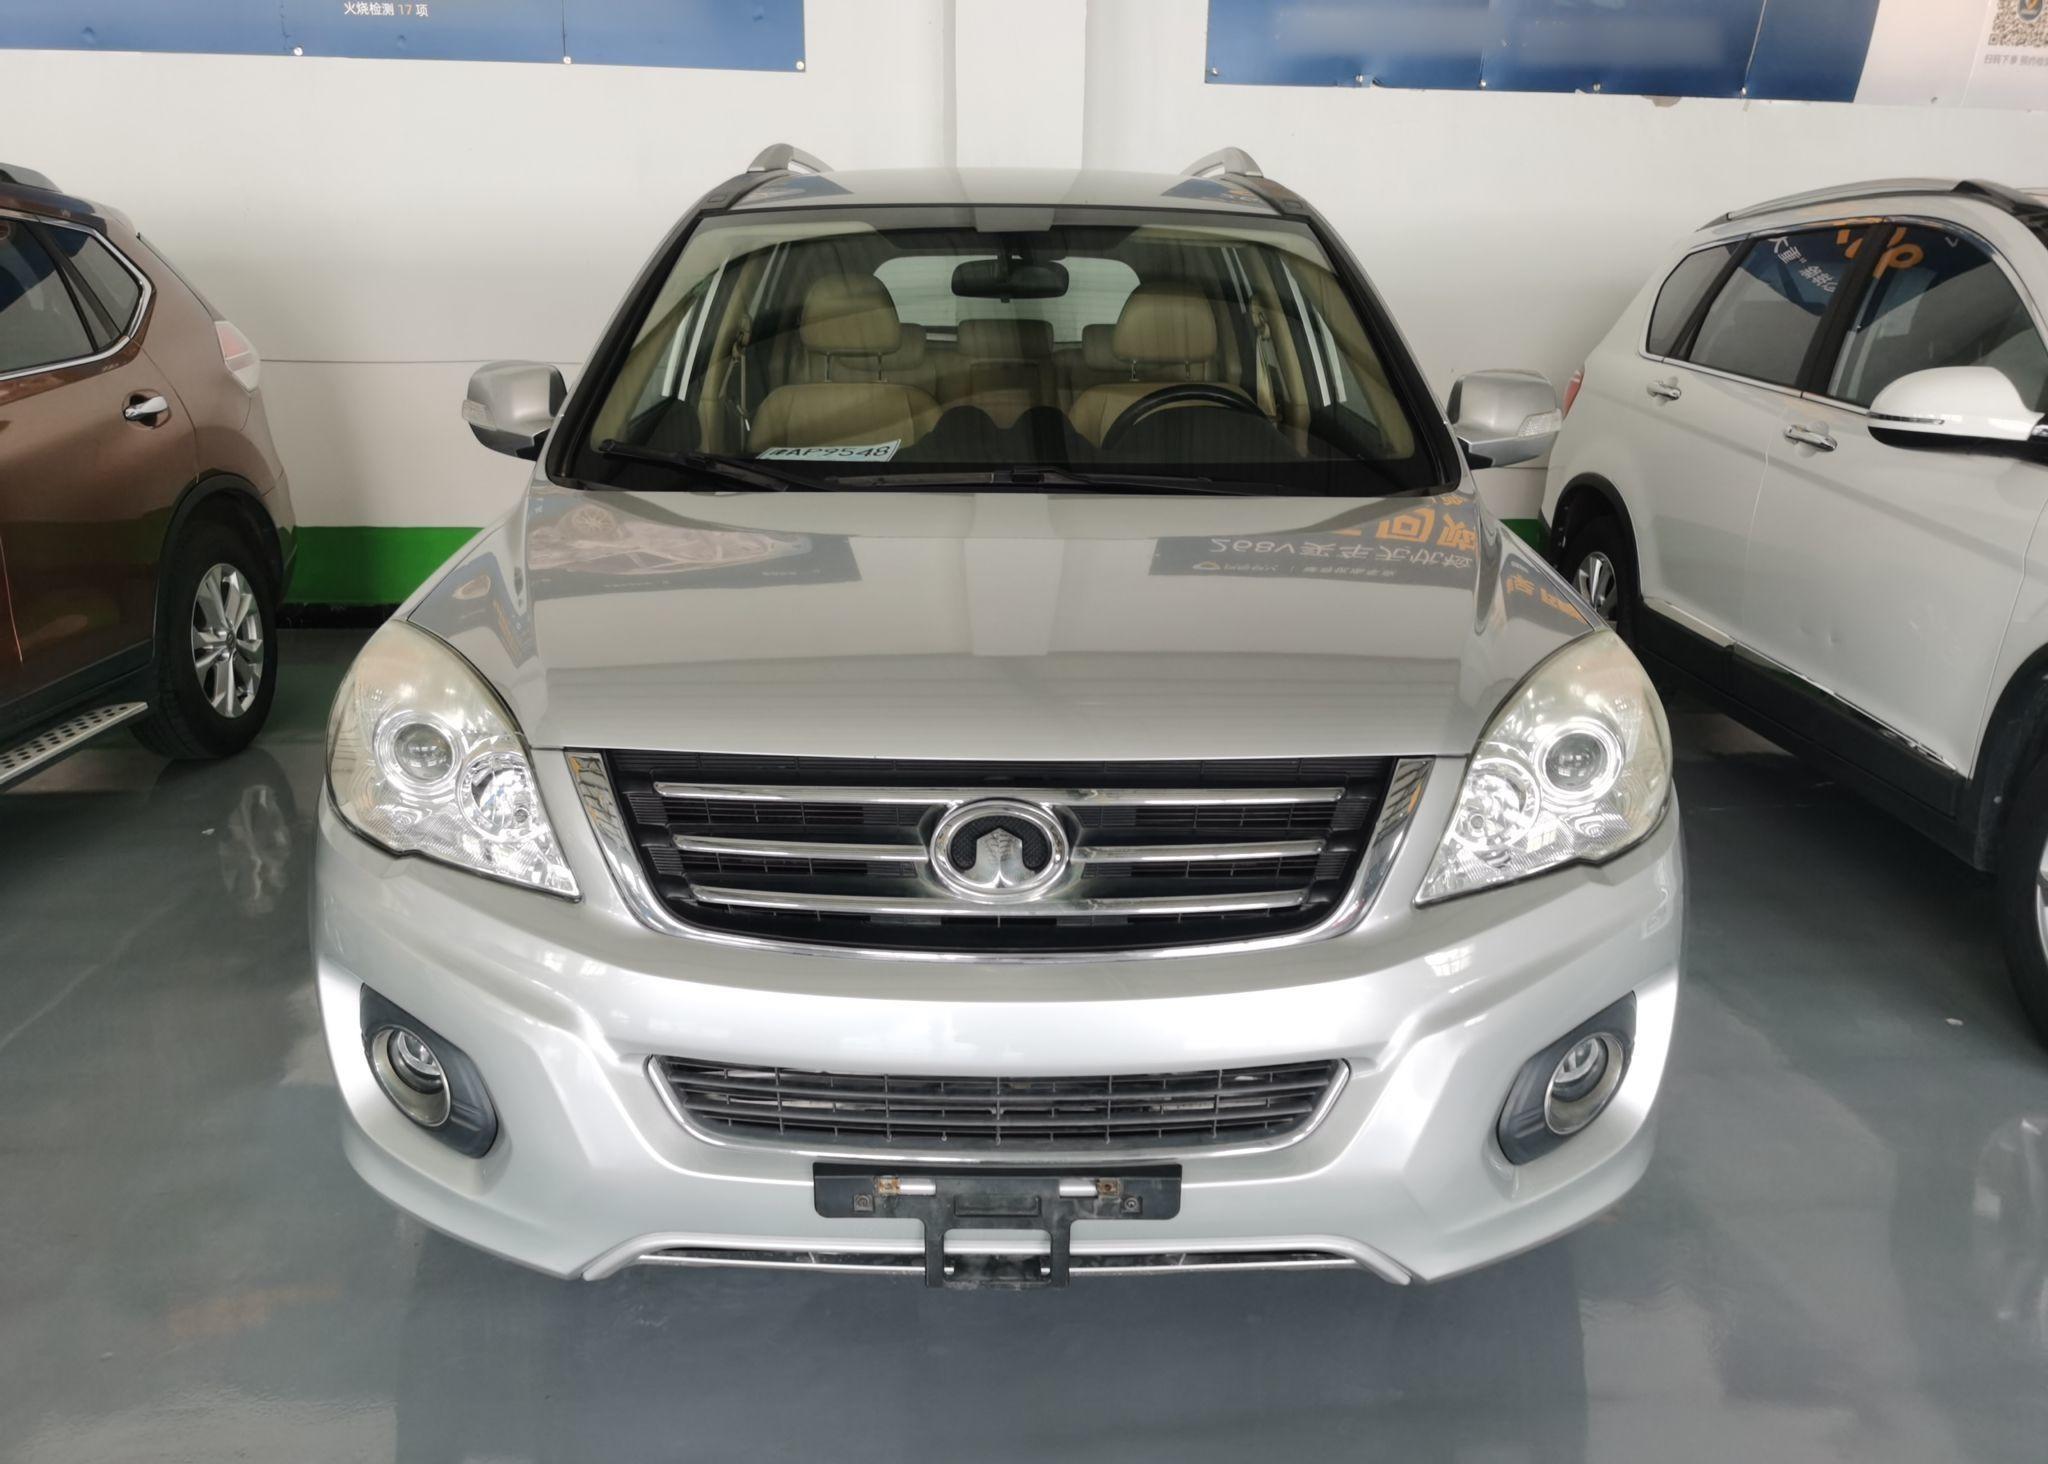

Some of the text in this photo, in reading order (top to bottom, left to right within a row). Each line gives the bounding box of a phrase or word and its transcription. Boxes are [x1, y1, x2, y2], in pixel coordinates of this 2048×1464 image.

[344, 2, 429, 17] 火烧检测 17 项
